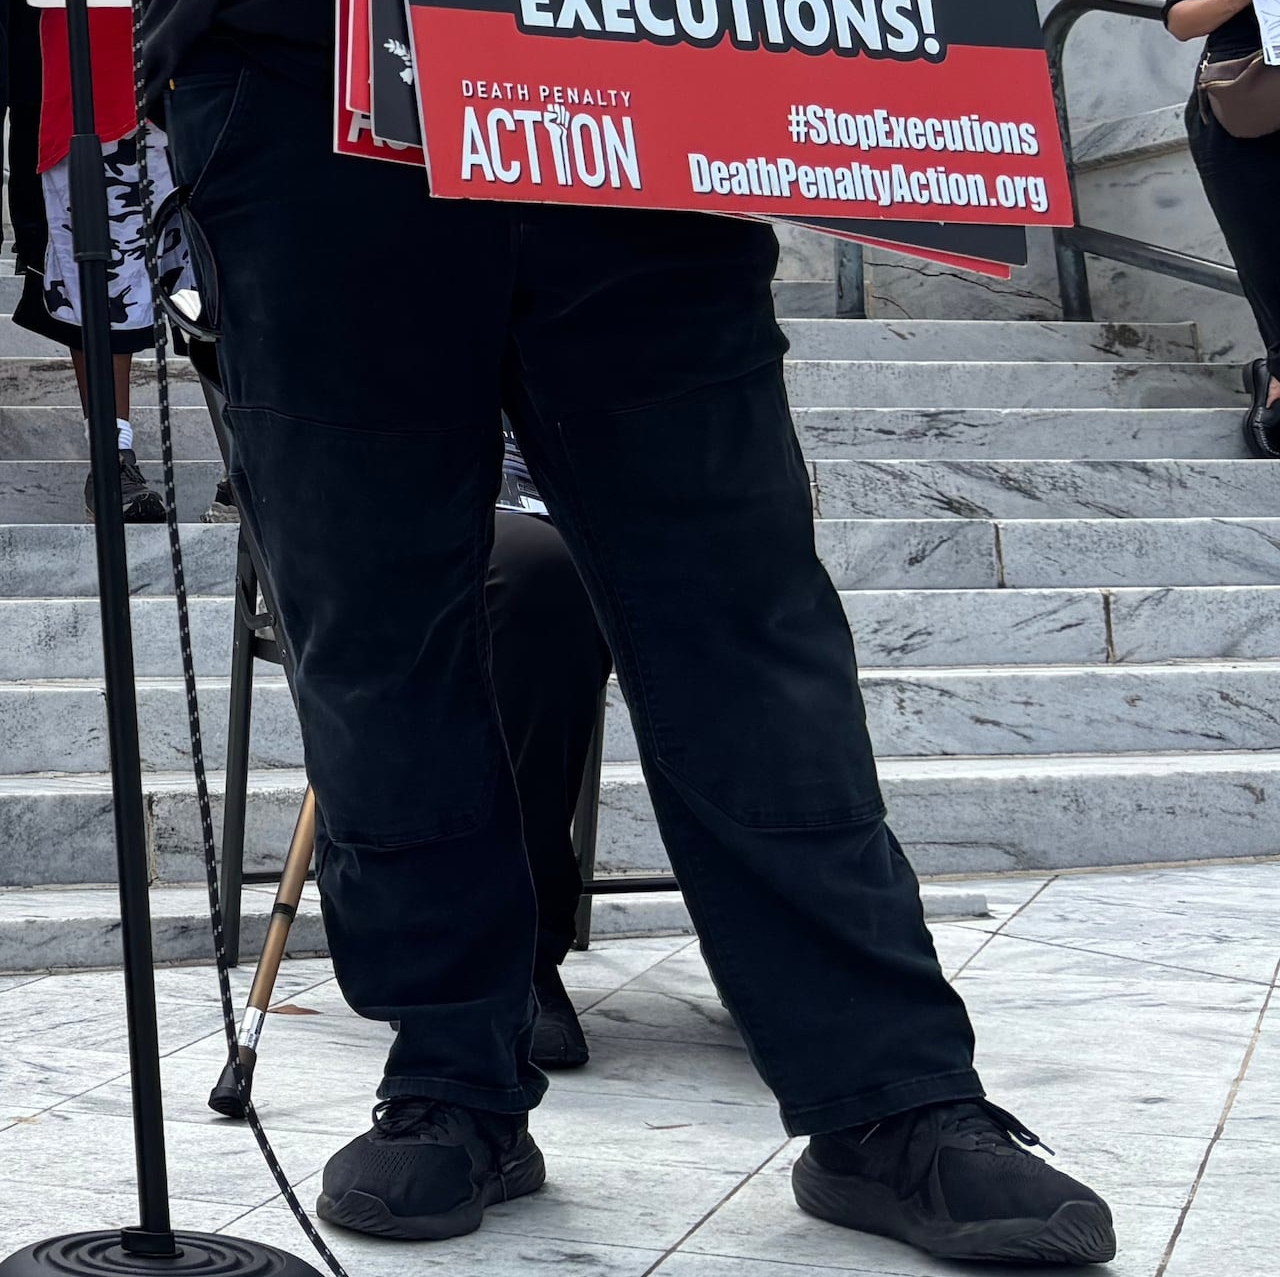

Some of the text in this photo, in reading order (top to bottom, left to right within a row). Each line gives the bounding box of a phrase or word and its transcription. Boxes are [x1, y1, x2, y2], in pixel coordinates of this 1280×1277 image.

[461, 79, 632, 108] DEATH PENALTY
[460, 104, 642, 190] ACTION
[787, 104, 1040, 156] #StopExecutions
[687, 153, 1049, 213] DeathPenaltyAction.org
